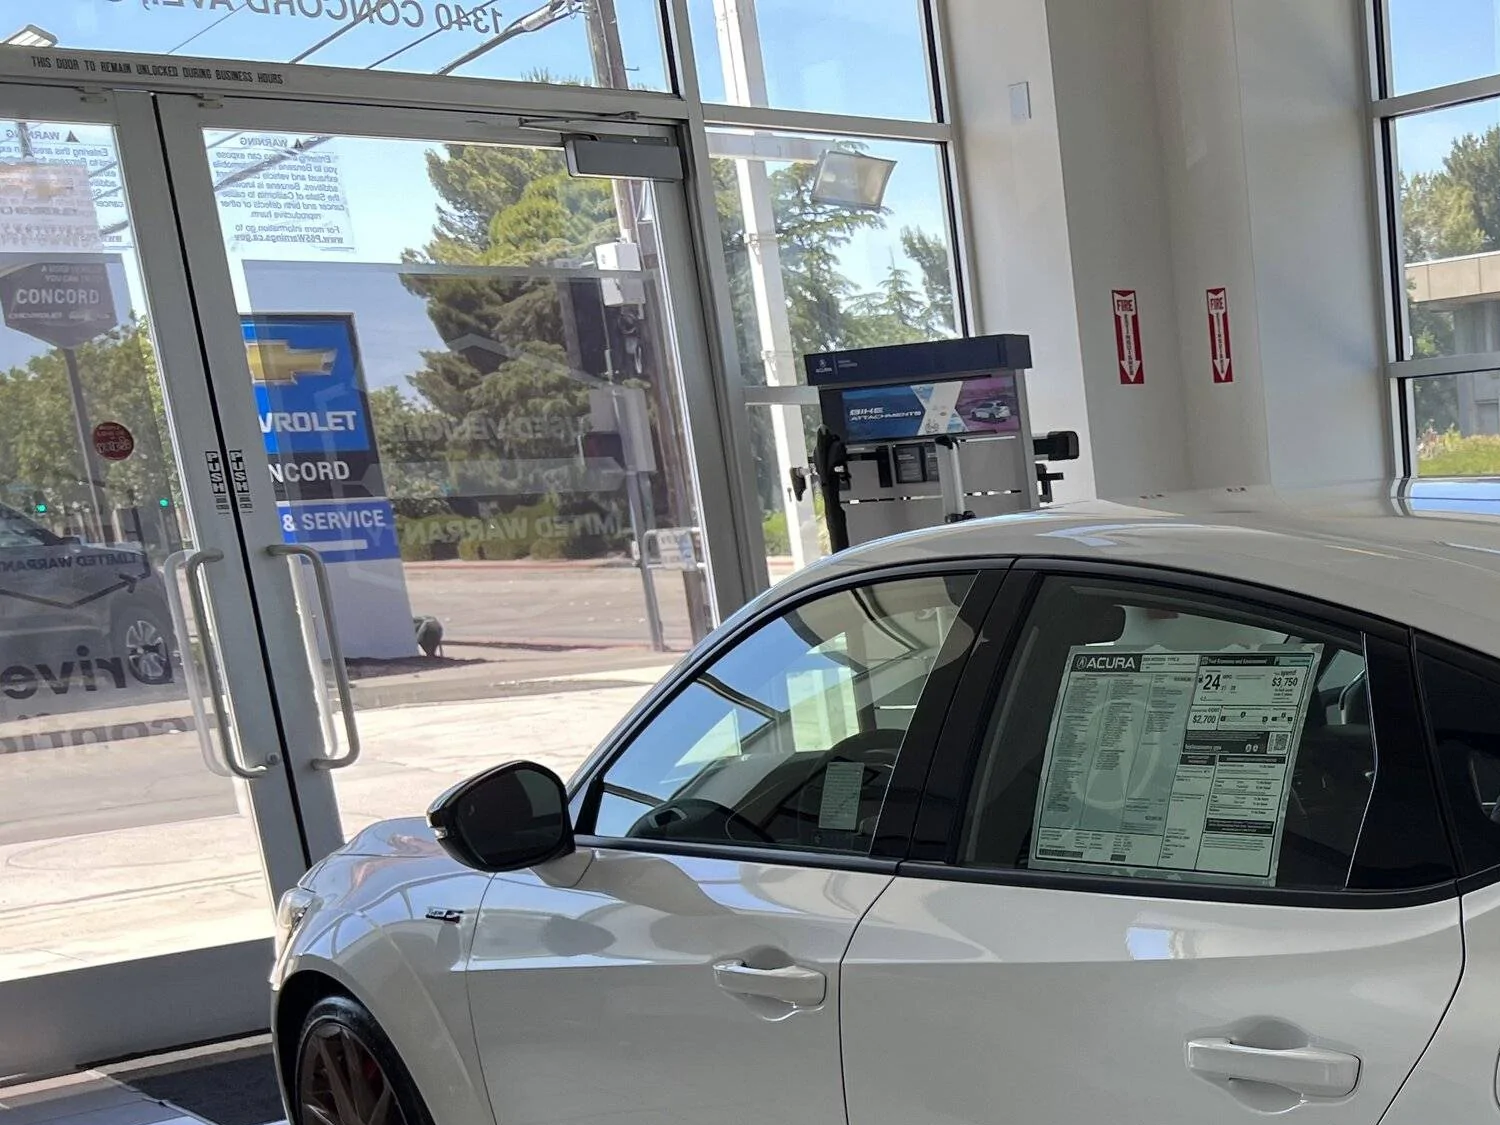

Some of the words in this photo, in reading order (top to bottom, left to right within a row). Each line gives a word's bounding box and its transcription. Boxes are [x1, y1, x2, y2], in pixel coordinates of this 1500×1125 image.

[31, 56, 51, 68] THIS
[56, 58, 80, 70] DOOR
[84, 60, 96, 71] TO
[101, 62, 132, 74] REMAIN
[136, 64, 178, 77] UNLOCKED
[183, 67, 212, 80] DURING
[216, 69, 253, 83] BUSINESS
[257, 73, 284, 85] HOURS
[16, 287, 100, 305] CONCORD
[1209, 297, 1225, 311] FIRE
[1116, 299, 1134, 312] FIRE
[205, 451, 226, 494] PUSH
[229, 450, 250, 493] PUSH
[282, 513, 296, 532] &
[301, 509, 387, 531] SERVICE
[1086, 656, 1136, 670] ACURA
[1202, 673, 1221, 691] 24
[1271, 676, 1298, 688] $3,750
[1193, 714, 1217, 724] $2,700
